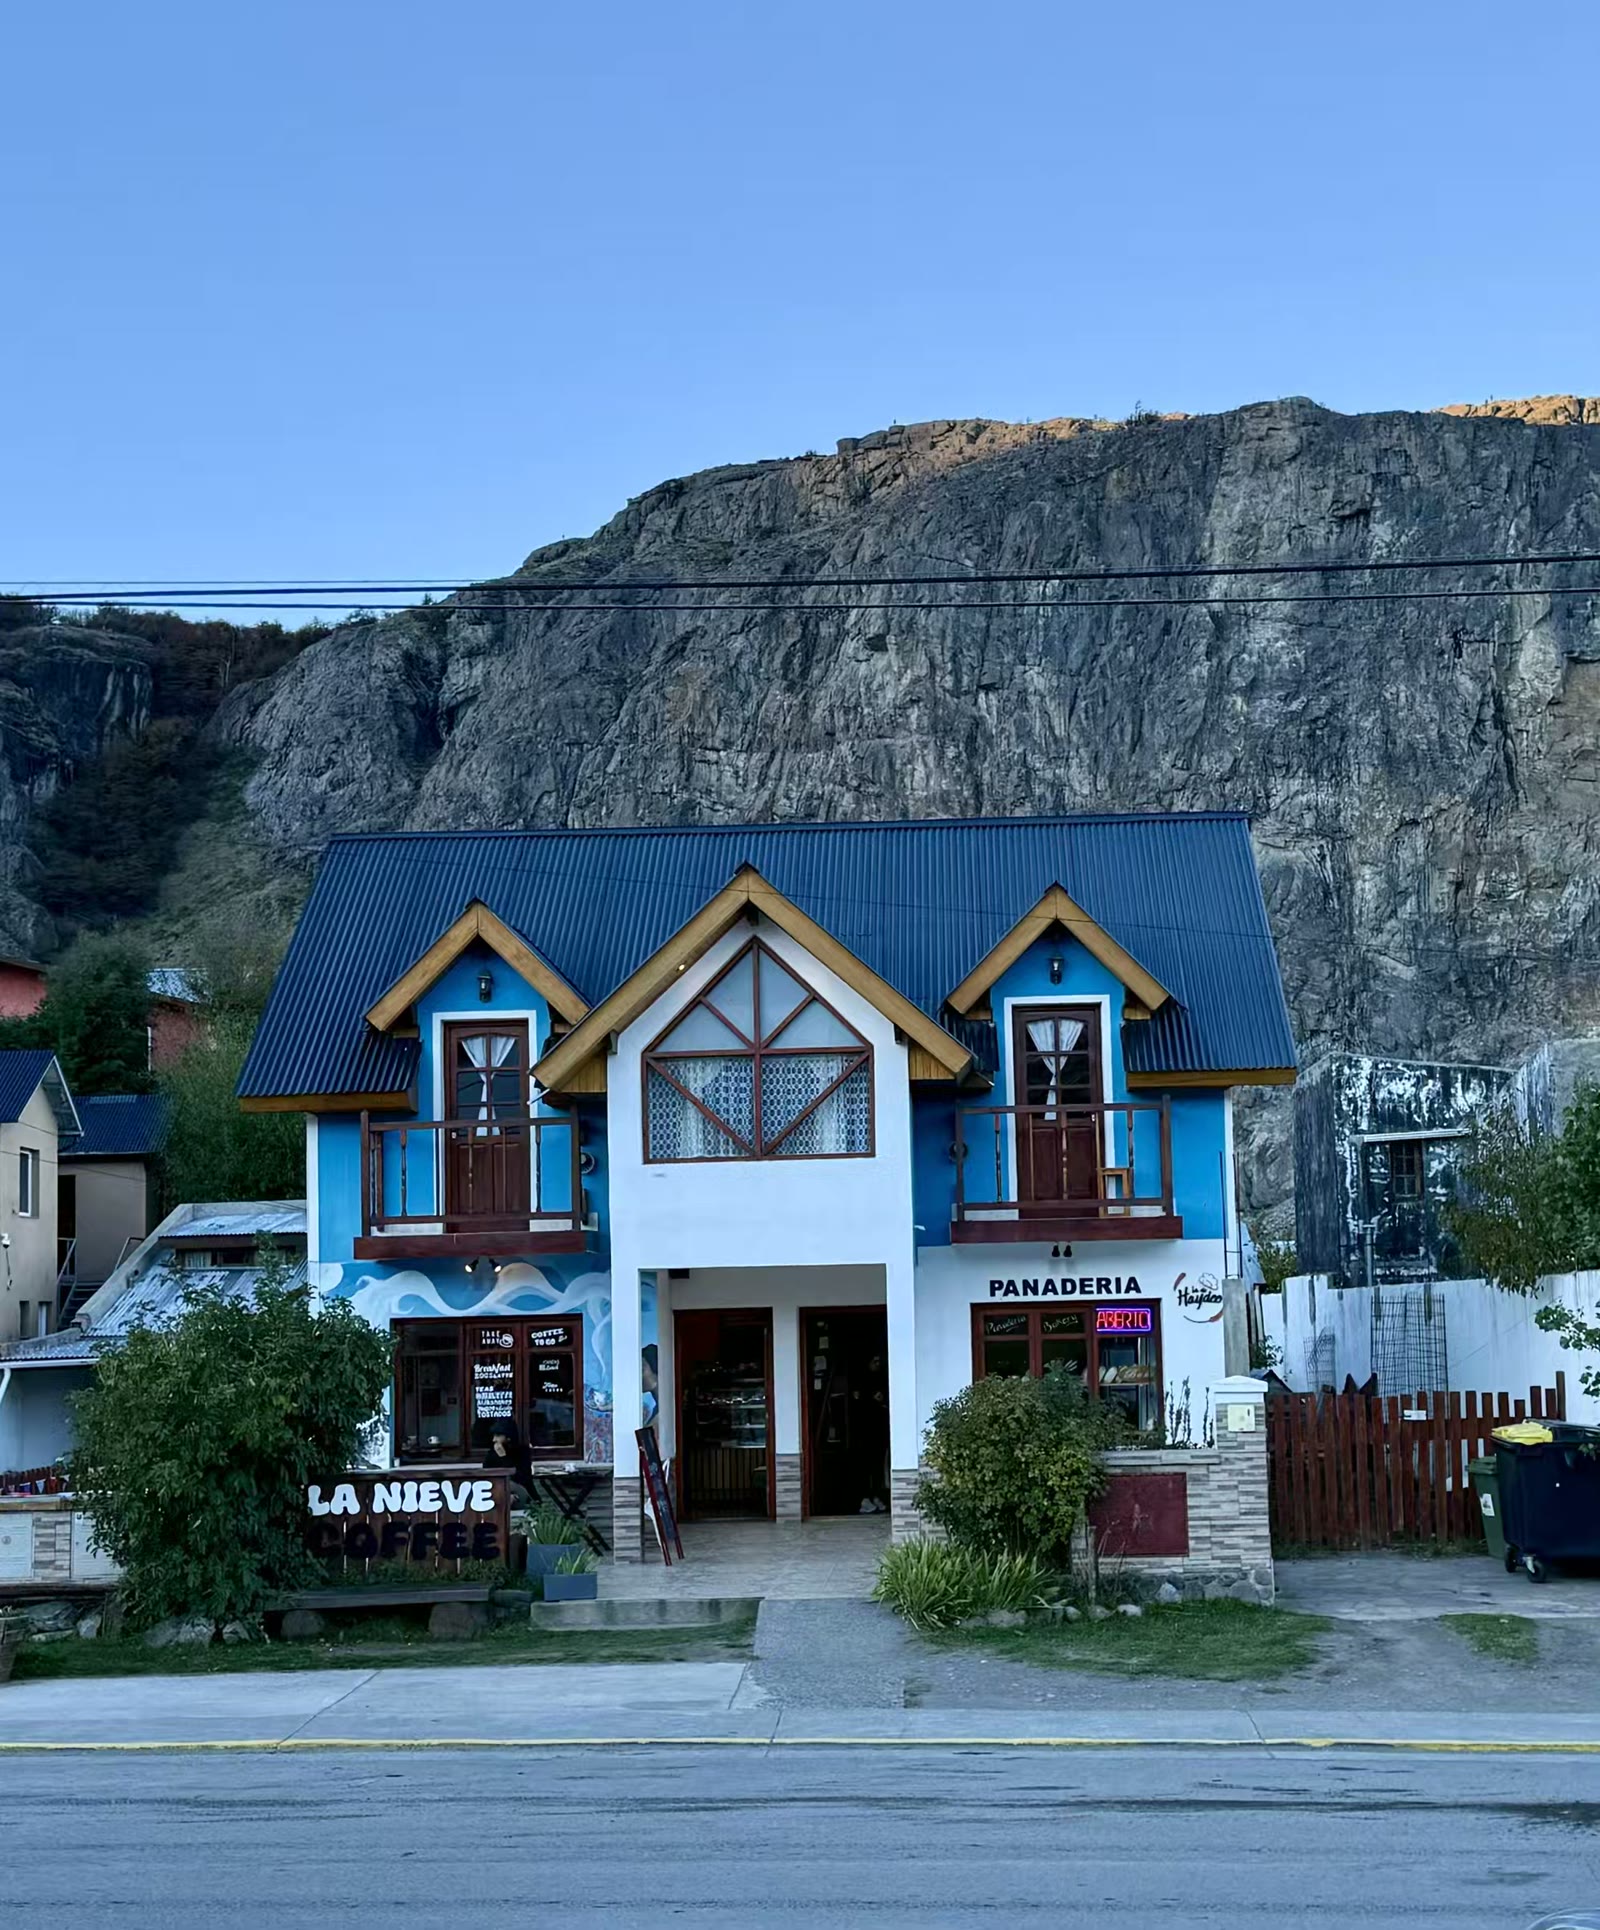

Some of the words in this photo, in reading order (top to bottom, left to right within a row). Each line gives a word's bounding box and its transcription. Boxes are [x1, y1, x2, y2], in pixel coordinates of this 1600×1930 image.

[989, 1276, 1142, 1297] PANADERIA
[1043, 1313, 1078, 1332] Bakery
[481, 1330, 500, 1338] TAKE
[531, 1328, 564, 1339] COFFEE
[307, 1483, 361, 1516] LA
[372, 1480, 496, 1514] NIEVE
[306, 1521, 501, 1561] COFFEE
